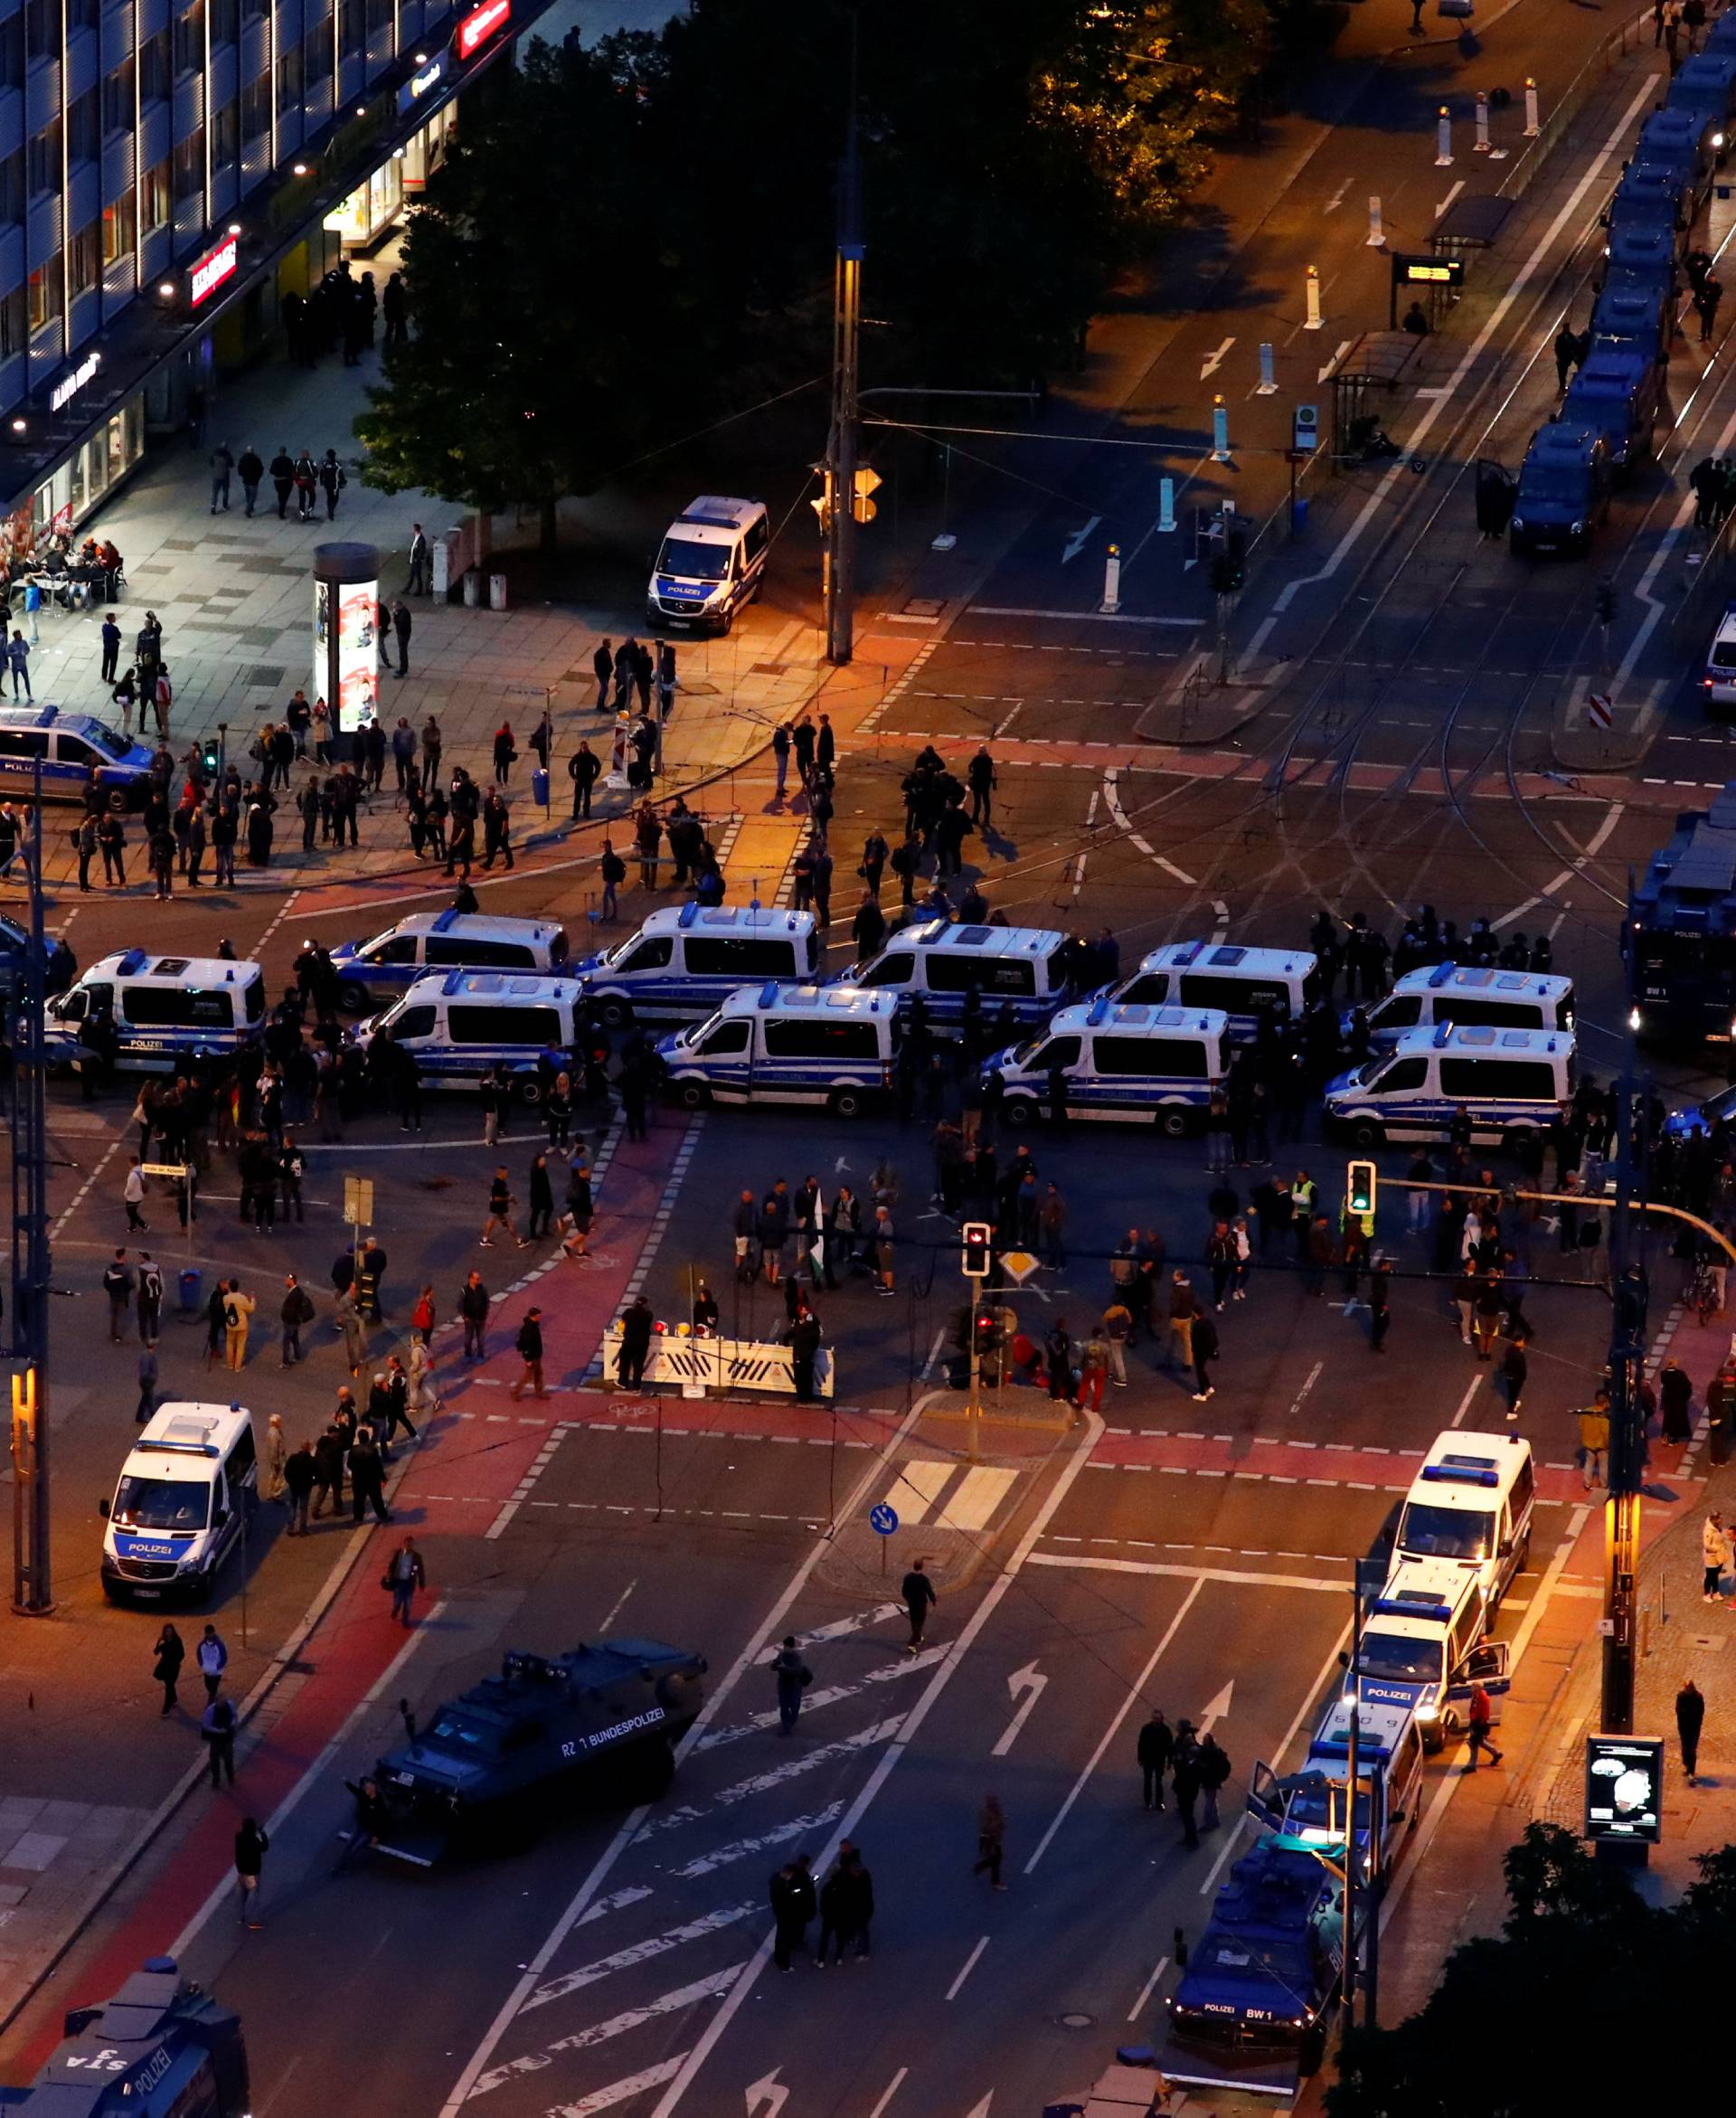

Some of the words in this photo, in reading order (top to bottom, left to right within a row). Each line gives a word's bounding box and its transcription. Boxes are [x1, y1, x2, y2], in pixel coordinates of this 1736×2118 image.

[667, 586, 702, 596] POLIZEI
[1674, 931, 1701, 939] POLIZEI
[130, 1039, 163, 1048] POLIZEI
[129, 1543, 172, 1555] POLIZEI
[1367, 1688, 1411, 1701] POLIZEI
[561, 1741, 576, 1757] RZ
[589, 1707, 665, 1747] BUNDESPOLIZEI
[1204, 2003, 1235, 2014] POLIZEI
[1246, 2009, 1265, 2019] BW
[1267, 2010, 1273, 2020] 1
[66, 2057, 128, 2071] STA
[135, 2047, 172, 2097] POLIZEI
